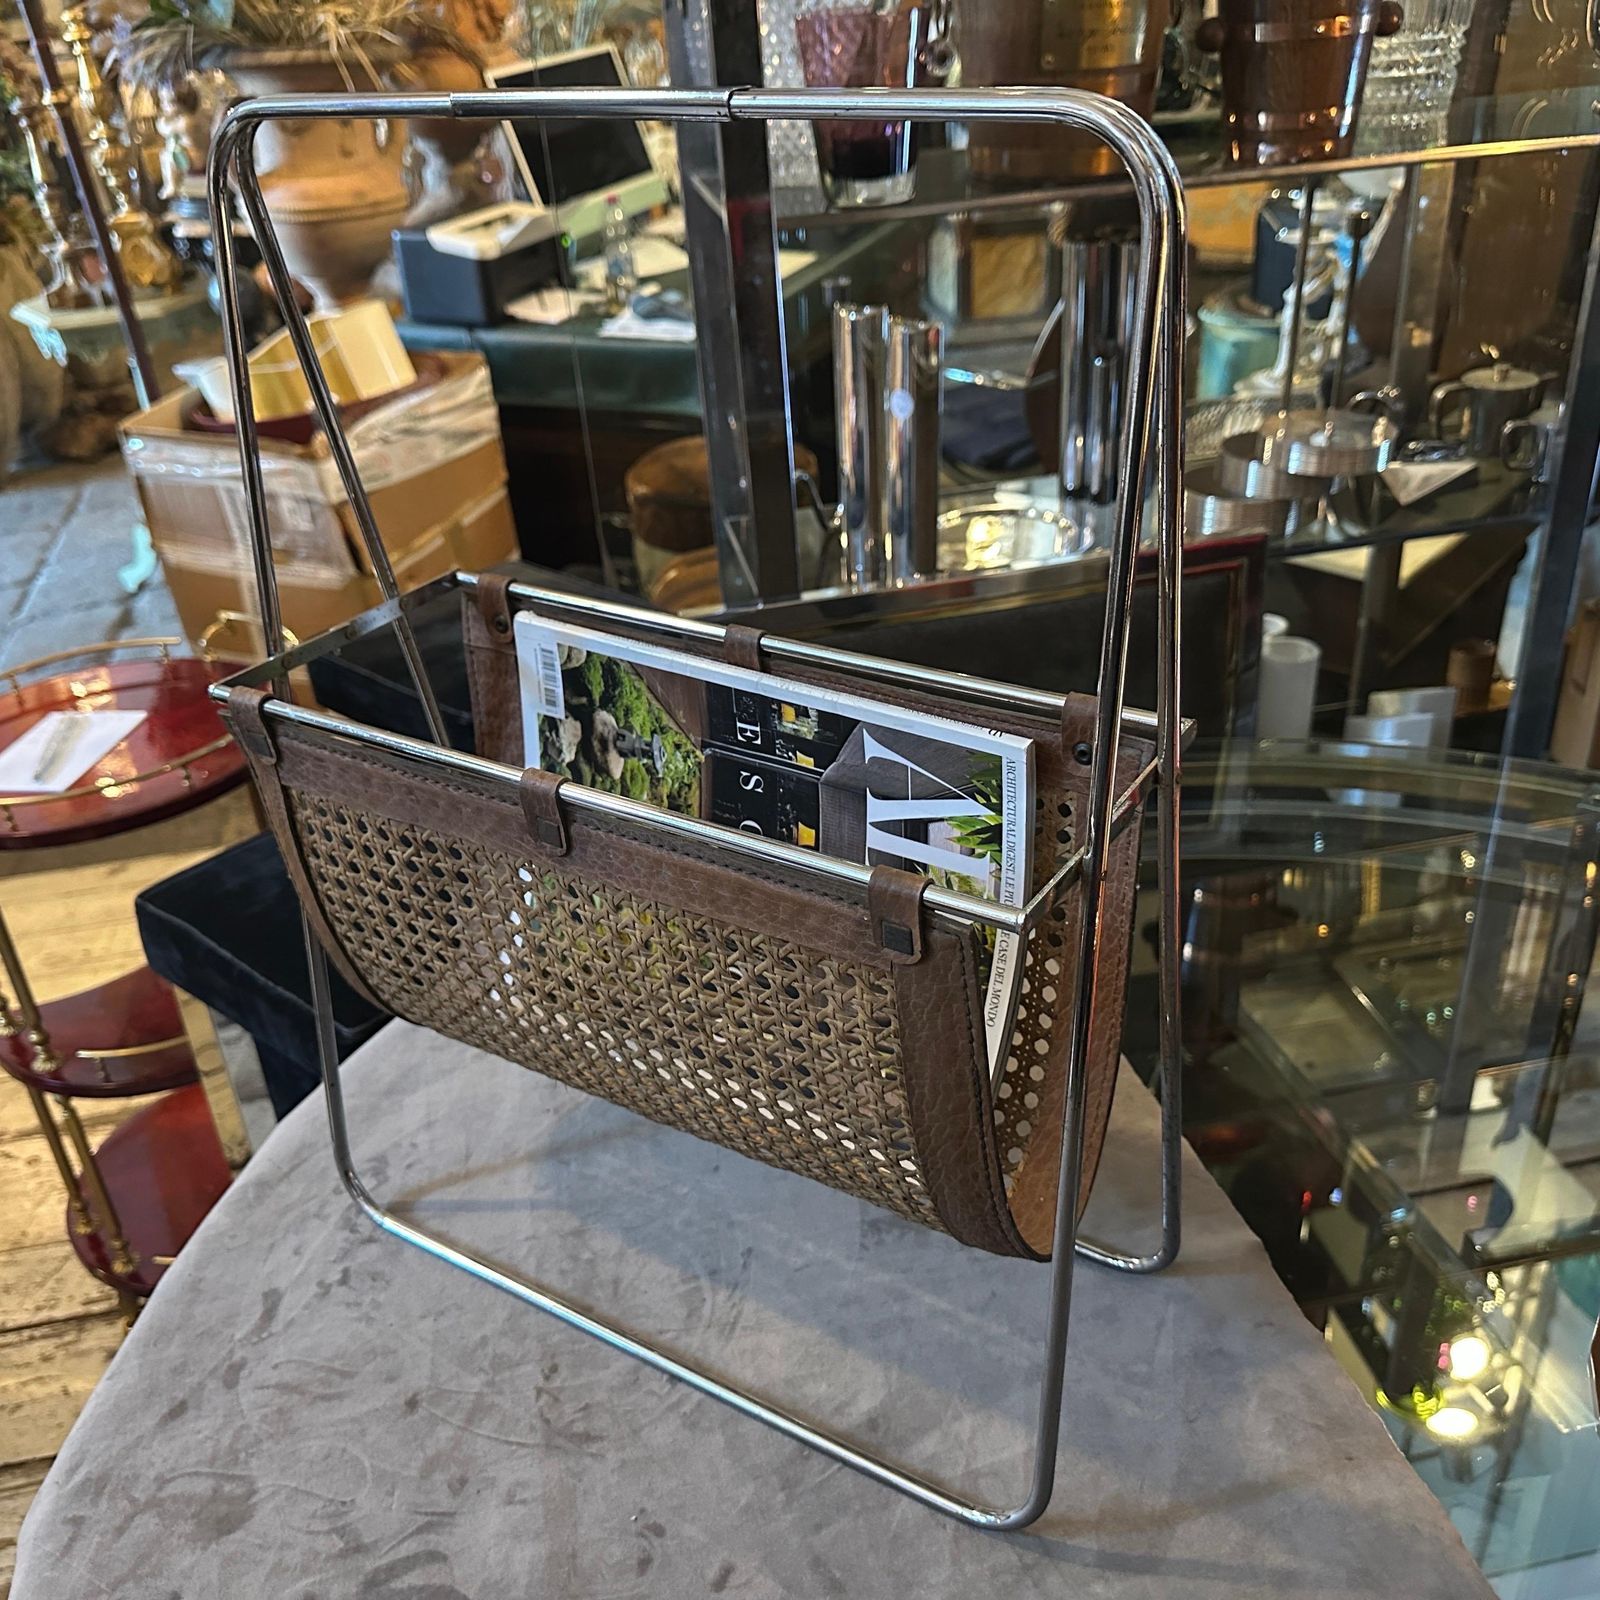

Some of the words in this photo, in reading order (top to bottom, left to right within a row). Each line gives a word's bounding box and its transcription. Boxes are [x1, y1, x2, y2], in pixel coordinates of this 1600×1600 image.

[1006, 757, 1017, 840] ARCHITECTURAL
[1004, 875, 1015, 890] LE
[997, 940, 1009, 965] CASE
[993, 966, 1005, 985] DEL
[986, 988, 1001, 1027] MONDO
